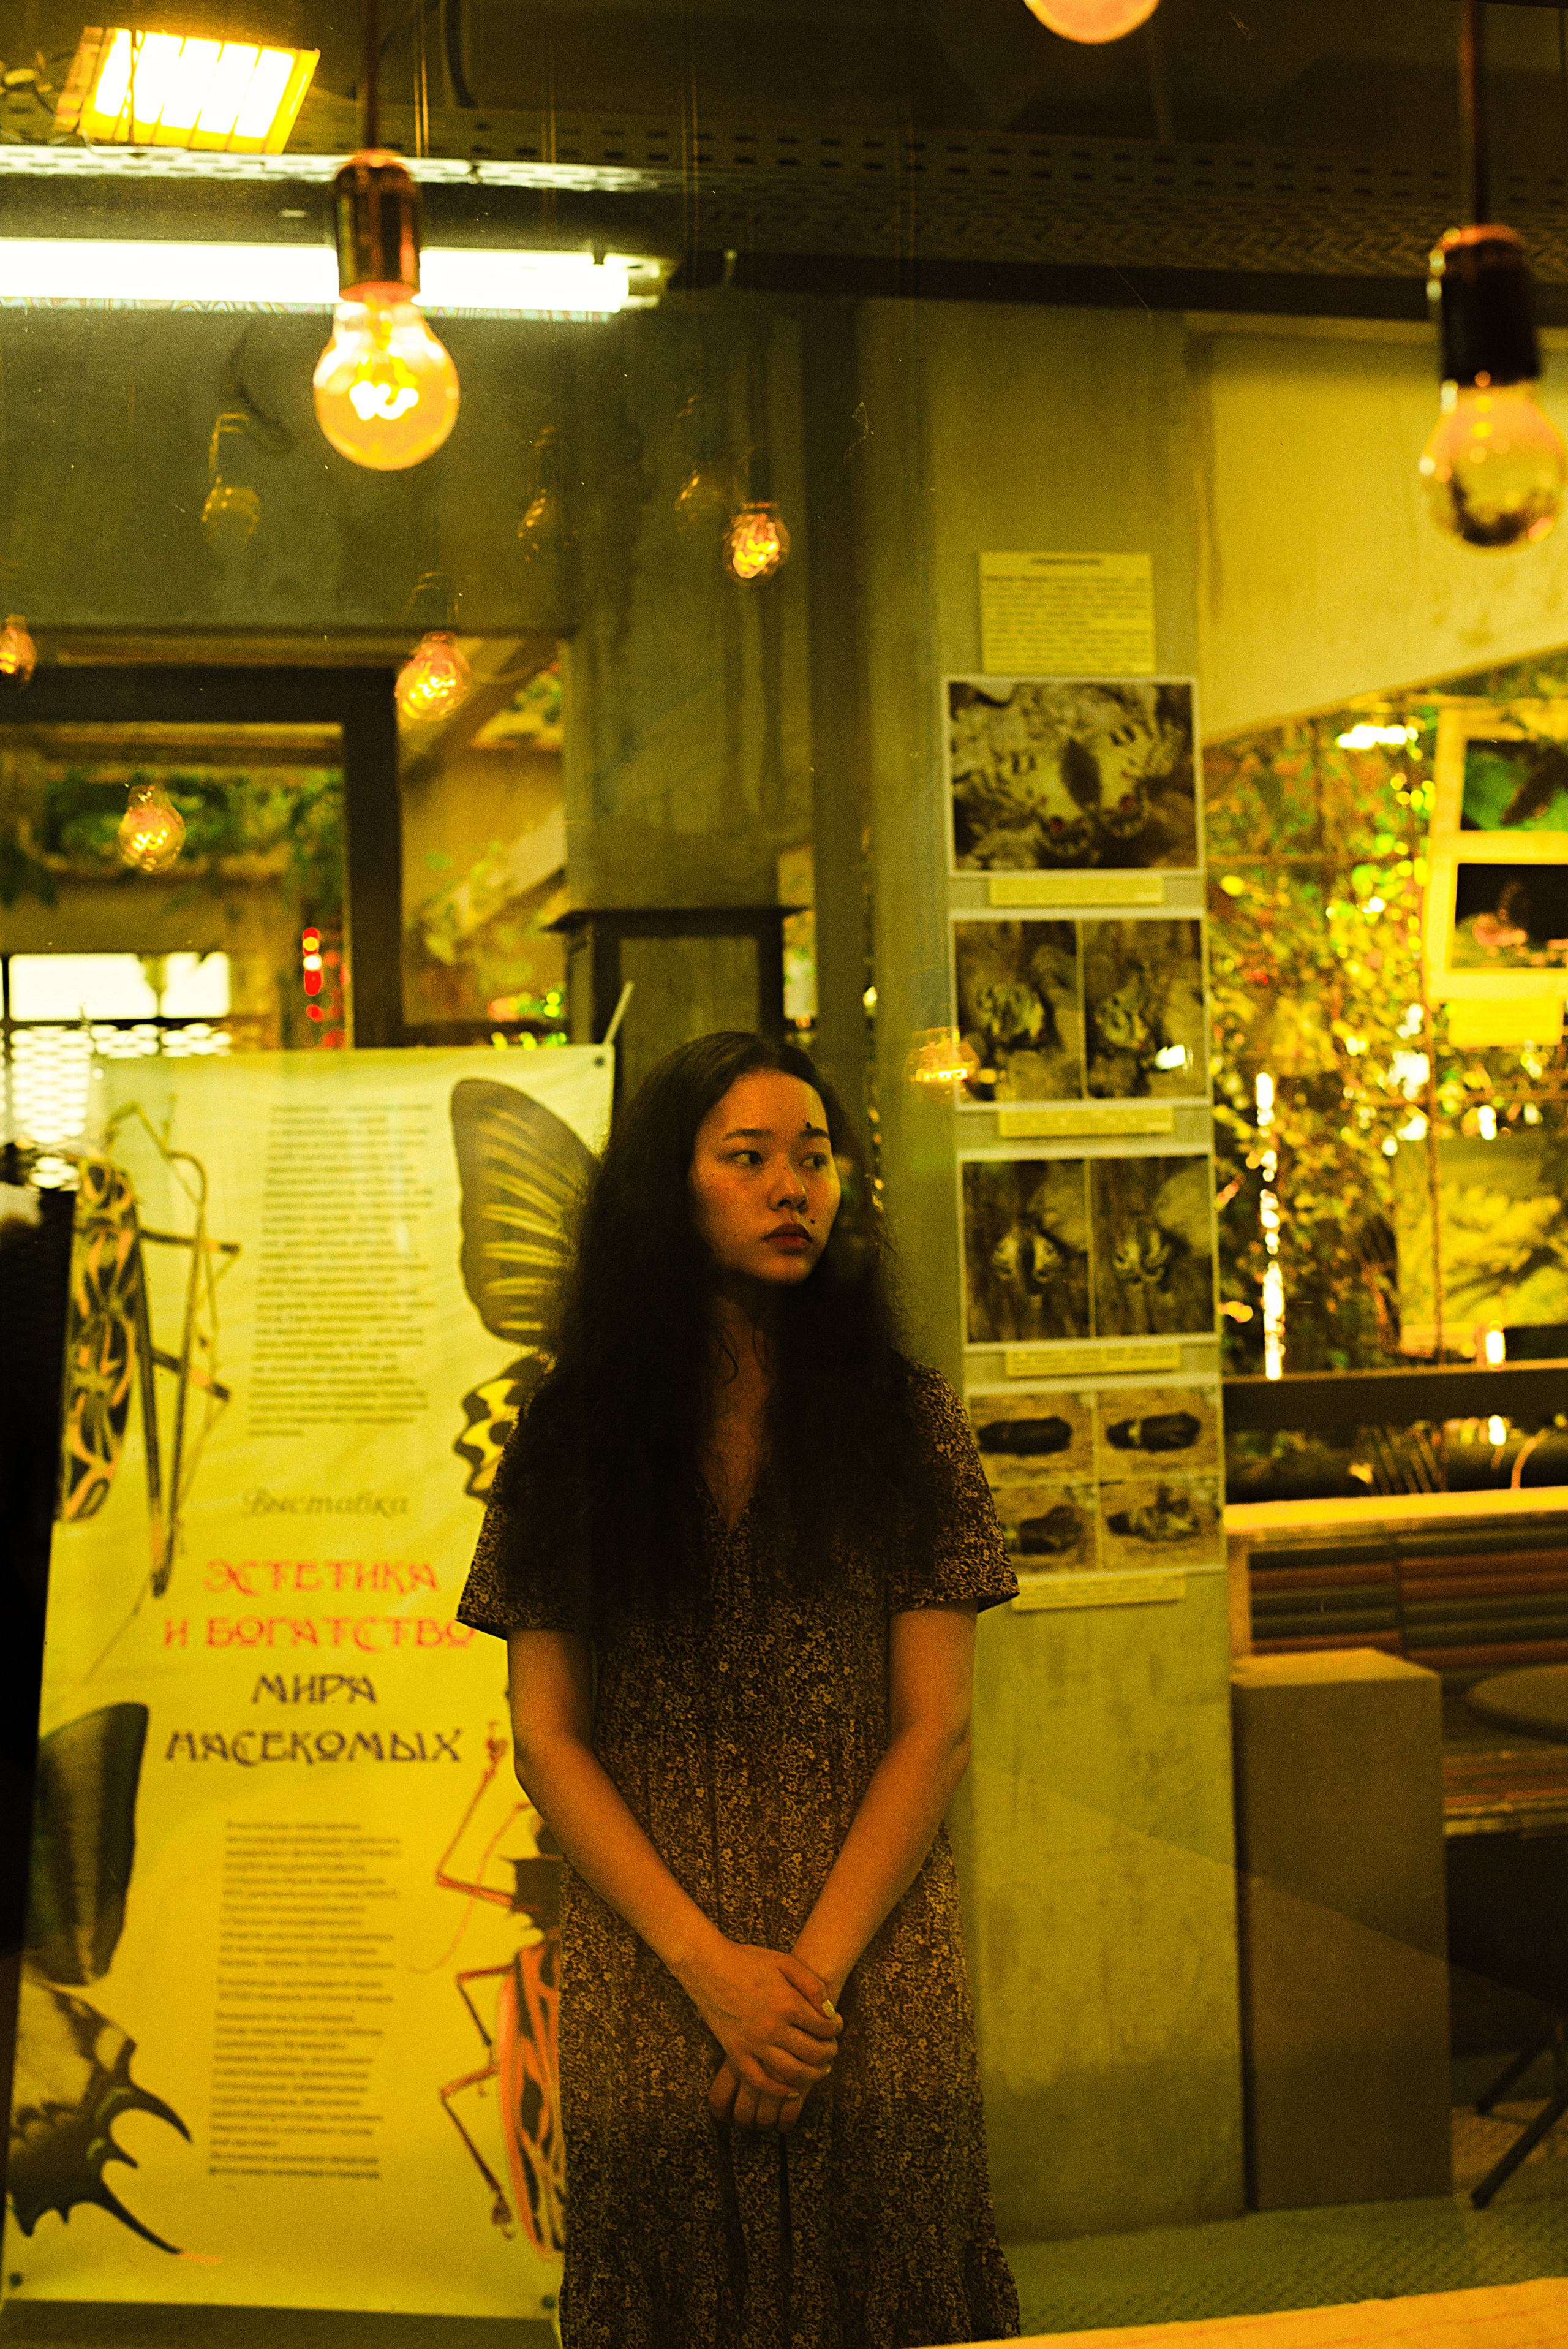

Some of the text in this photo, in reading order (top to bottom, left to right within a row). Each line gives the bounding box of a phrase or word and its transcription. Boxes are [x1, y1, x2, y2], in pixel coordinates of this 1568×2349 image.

[244, 1487, 409, 1519] Выставка
[203, 1559, 439, 1597] ЭСТЕТИКА
[164, 1616, 475, 1653] И БОГАТСТВО
[251, 1673, 377, 1704] МИРА
[165, 1728, 462, 1766] НАСЕКОМЫХ
